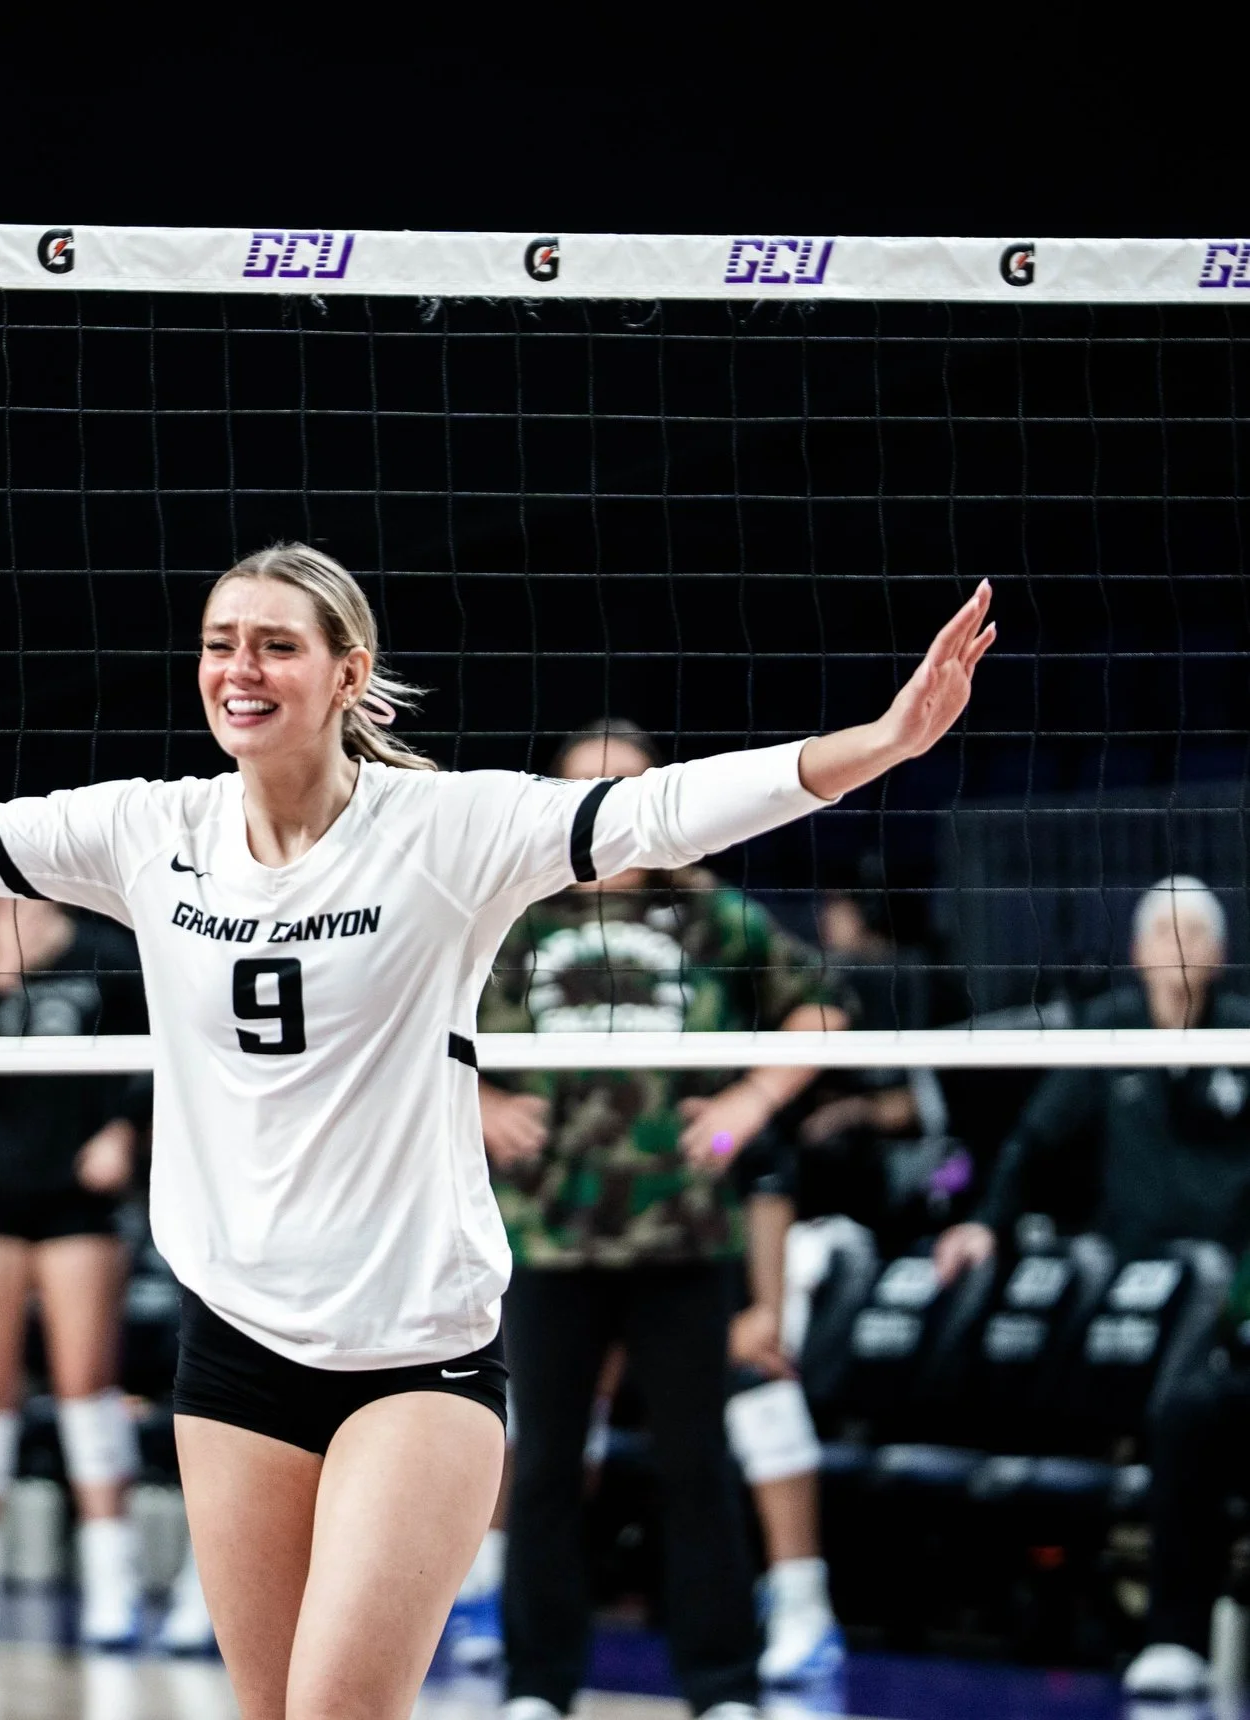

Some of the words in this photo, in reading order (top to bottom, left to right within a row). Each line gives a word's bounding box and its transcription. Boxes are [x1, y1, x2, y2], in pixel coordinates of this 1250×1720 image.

[242, 231, 356, 280] GCU
[724, 239, 835, 285] GCU
[171, 900, 259, 943] GRAND
[267, 905, 382, 944] CANYON
[232, 957, 307, 1056] 9
